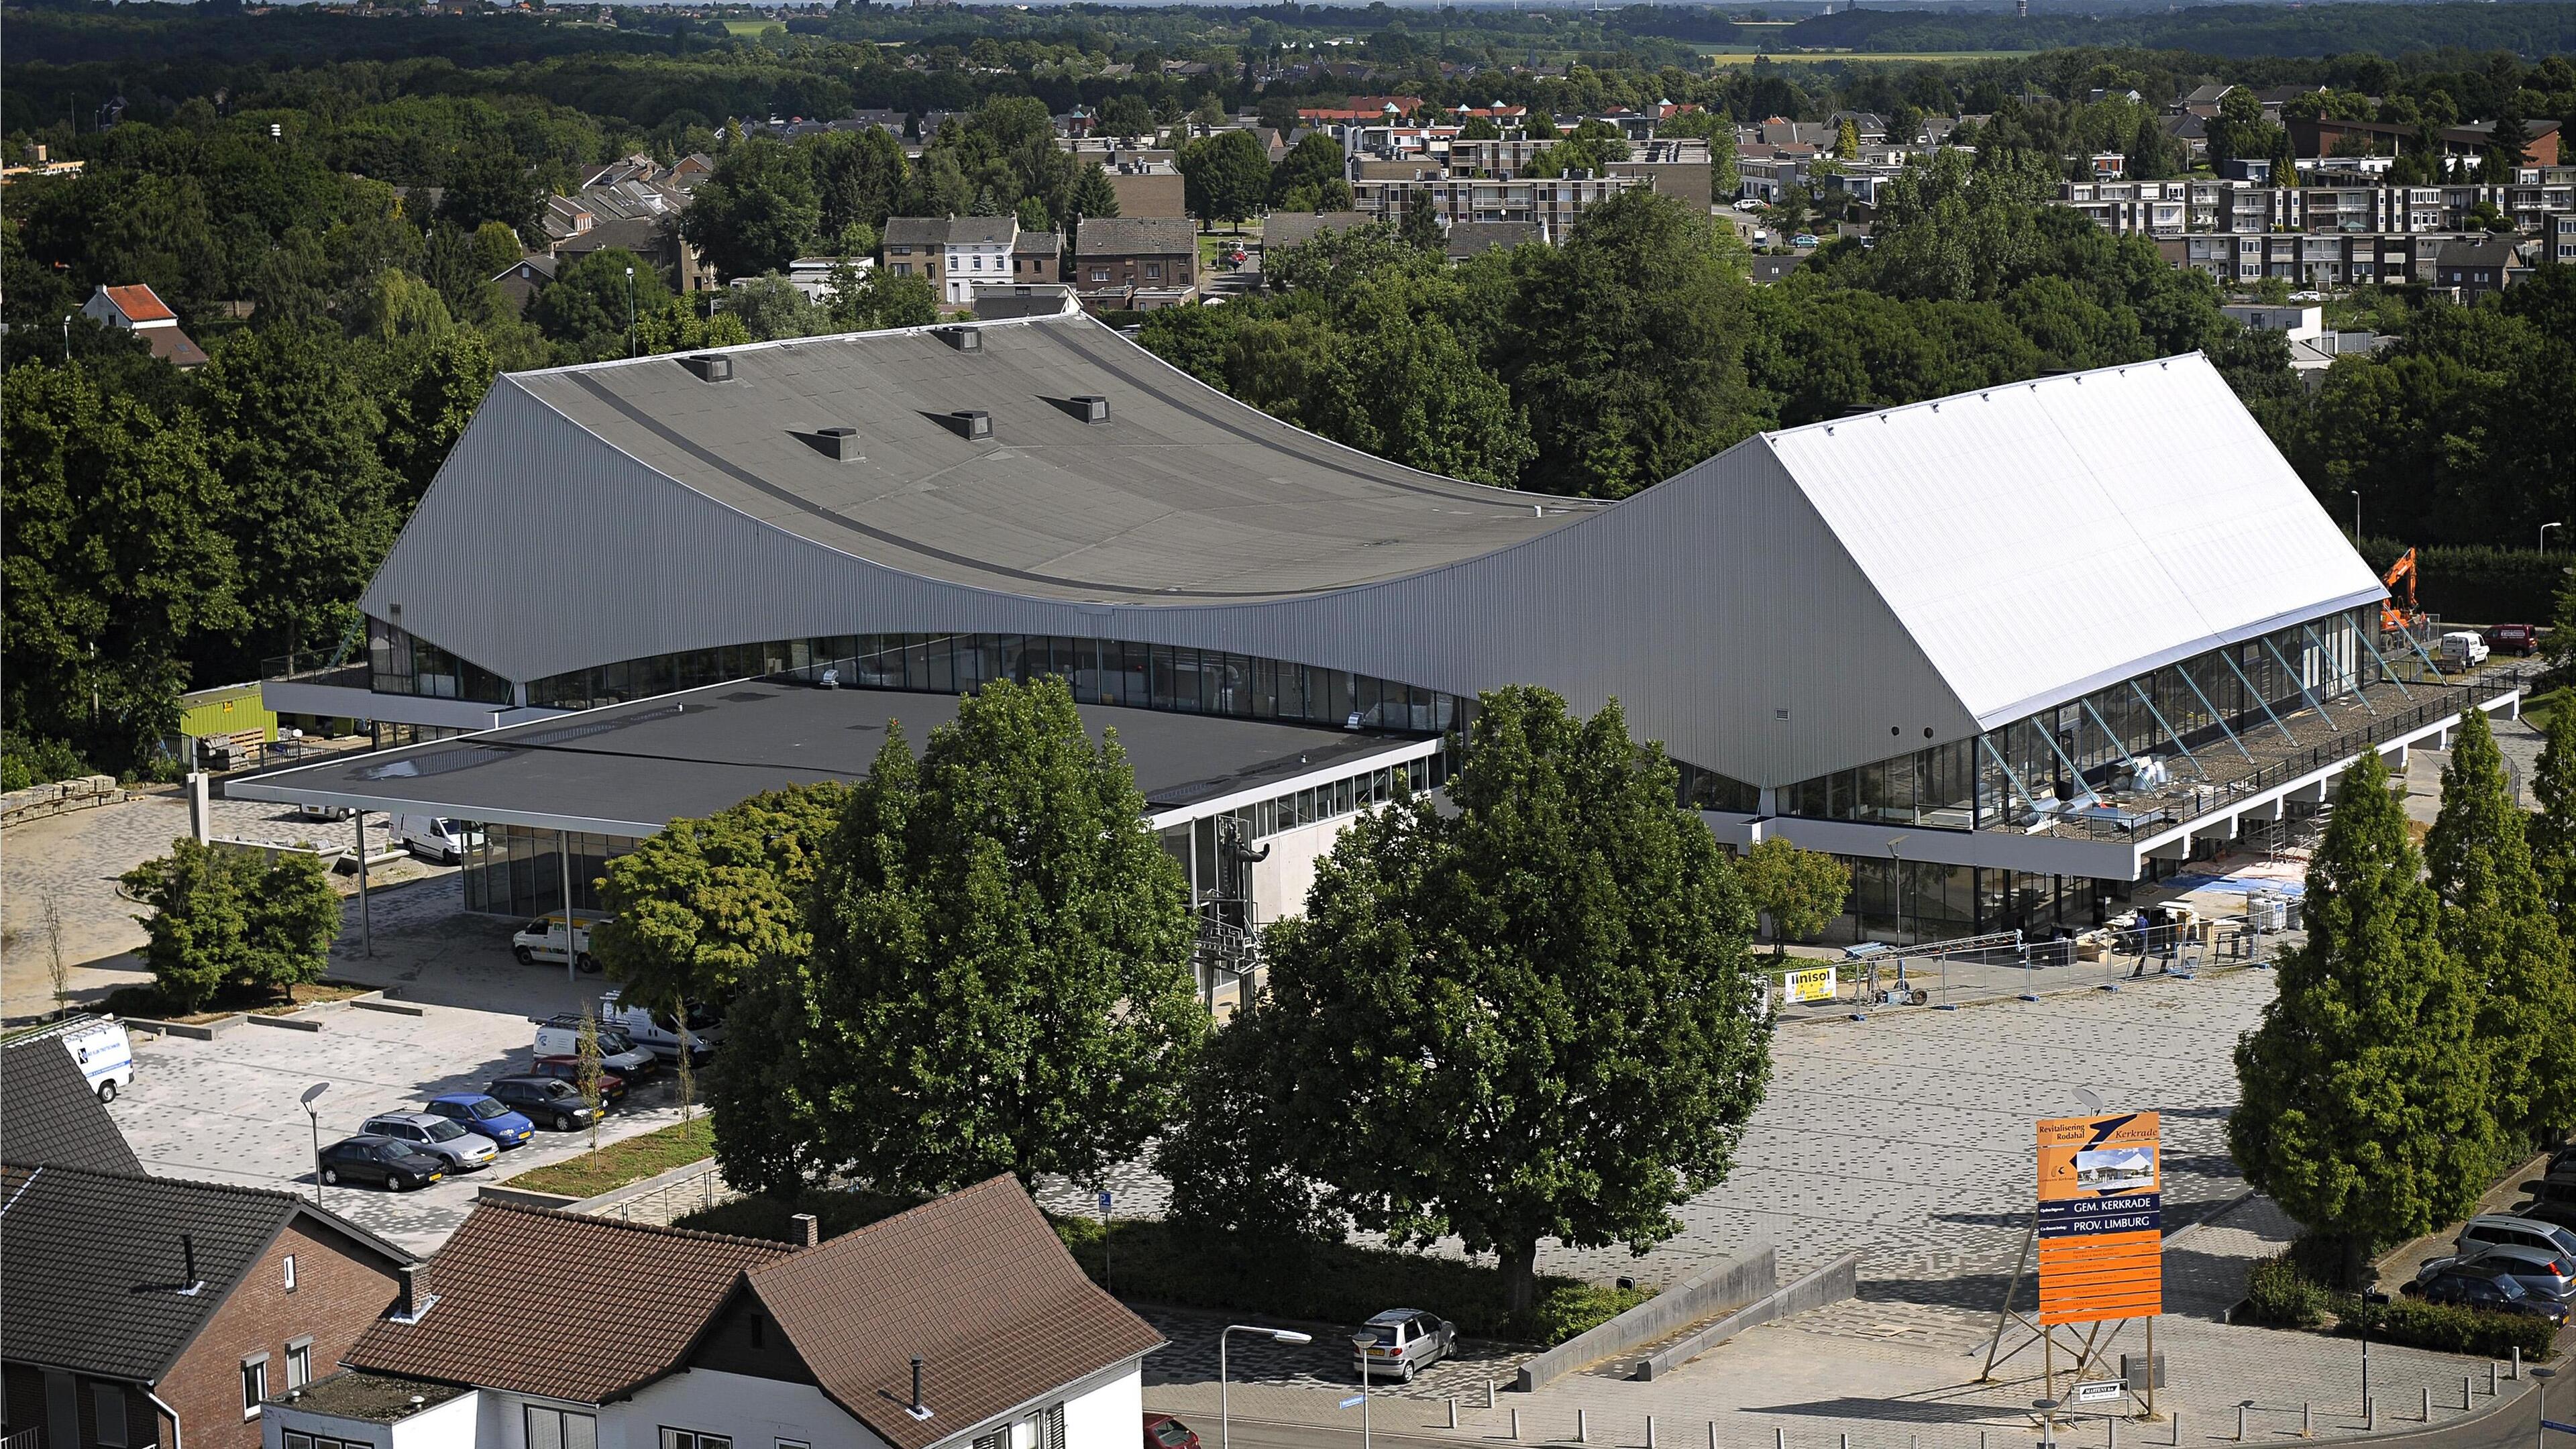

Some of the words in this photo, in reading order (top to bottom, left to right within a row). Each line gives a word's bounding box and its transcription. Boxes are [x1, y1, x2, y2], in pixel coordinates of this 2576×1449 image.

[1791, 970, 1830, 984] linisol
[2039, 1123, 2085, 1133] Revitalisering
[2115, 1128, 2157, 1138] Kerkrade
[2057, 1130, 2085, 1140] Rodahal
[1100, 1194, 1106, 1204] P
[2074, 1203, 2099, 1213] GEM.
[2102, 1197, 2151, 1210] KERKRADE
[2074, 1220, 2102, 1231] PROV.
[2104, 1216, 2149, 1229] LIMBURG
